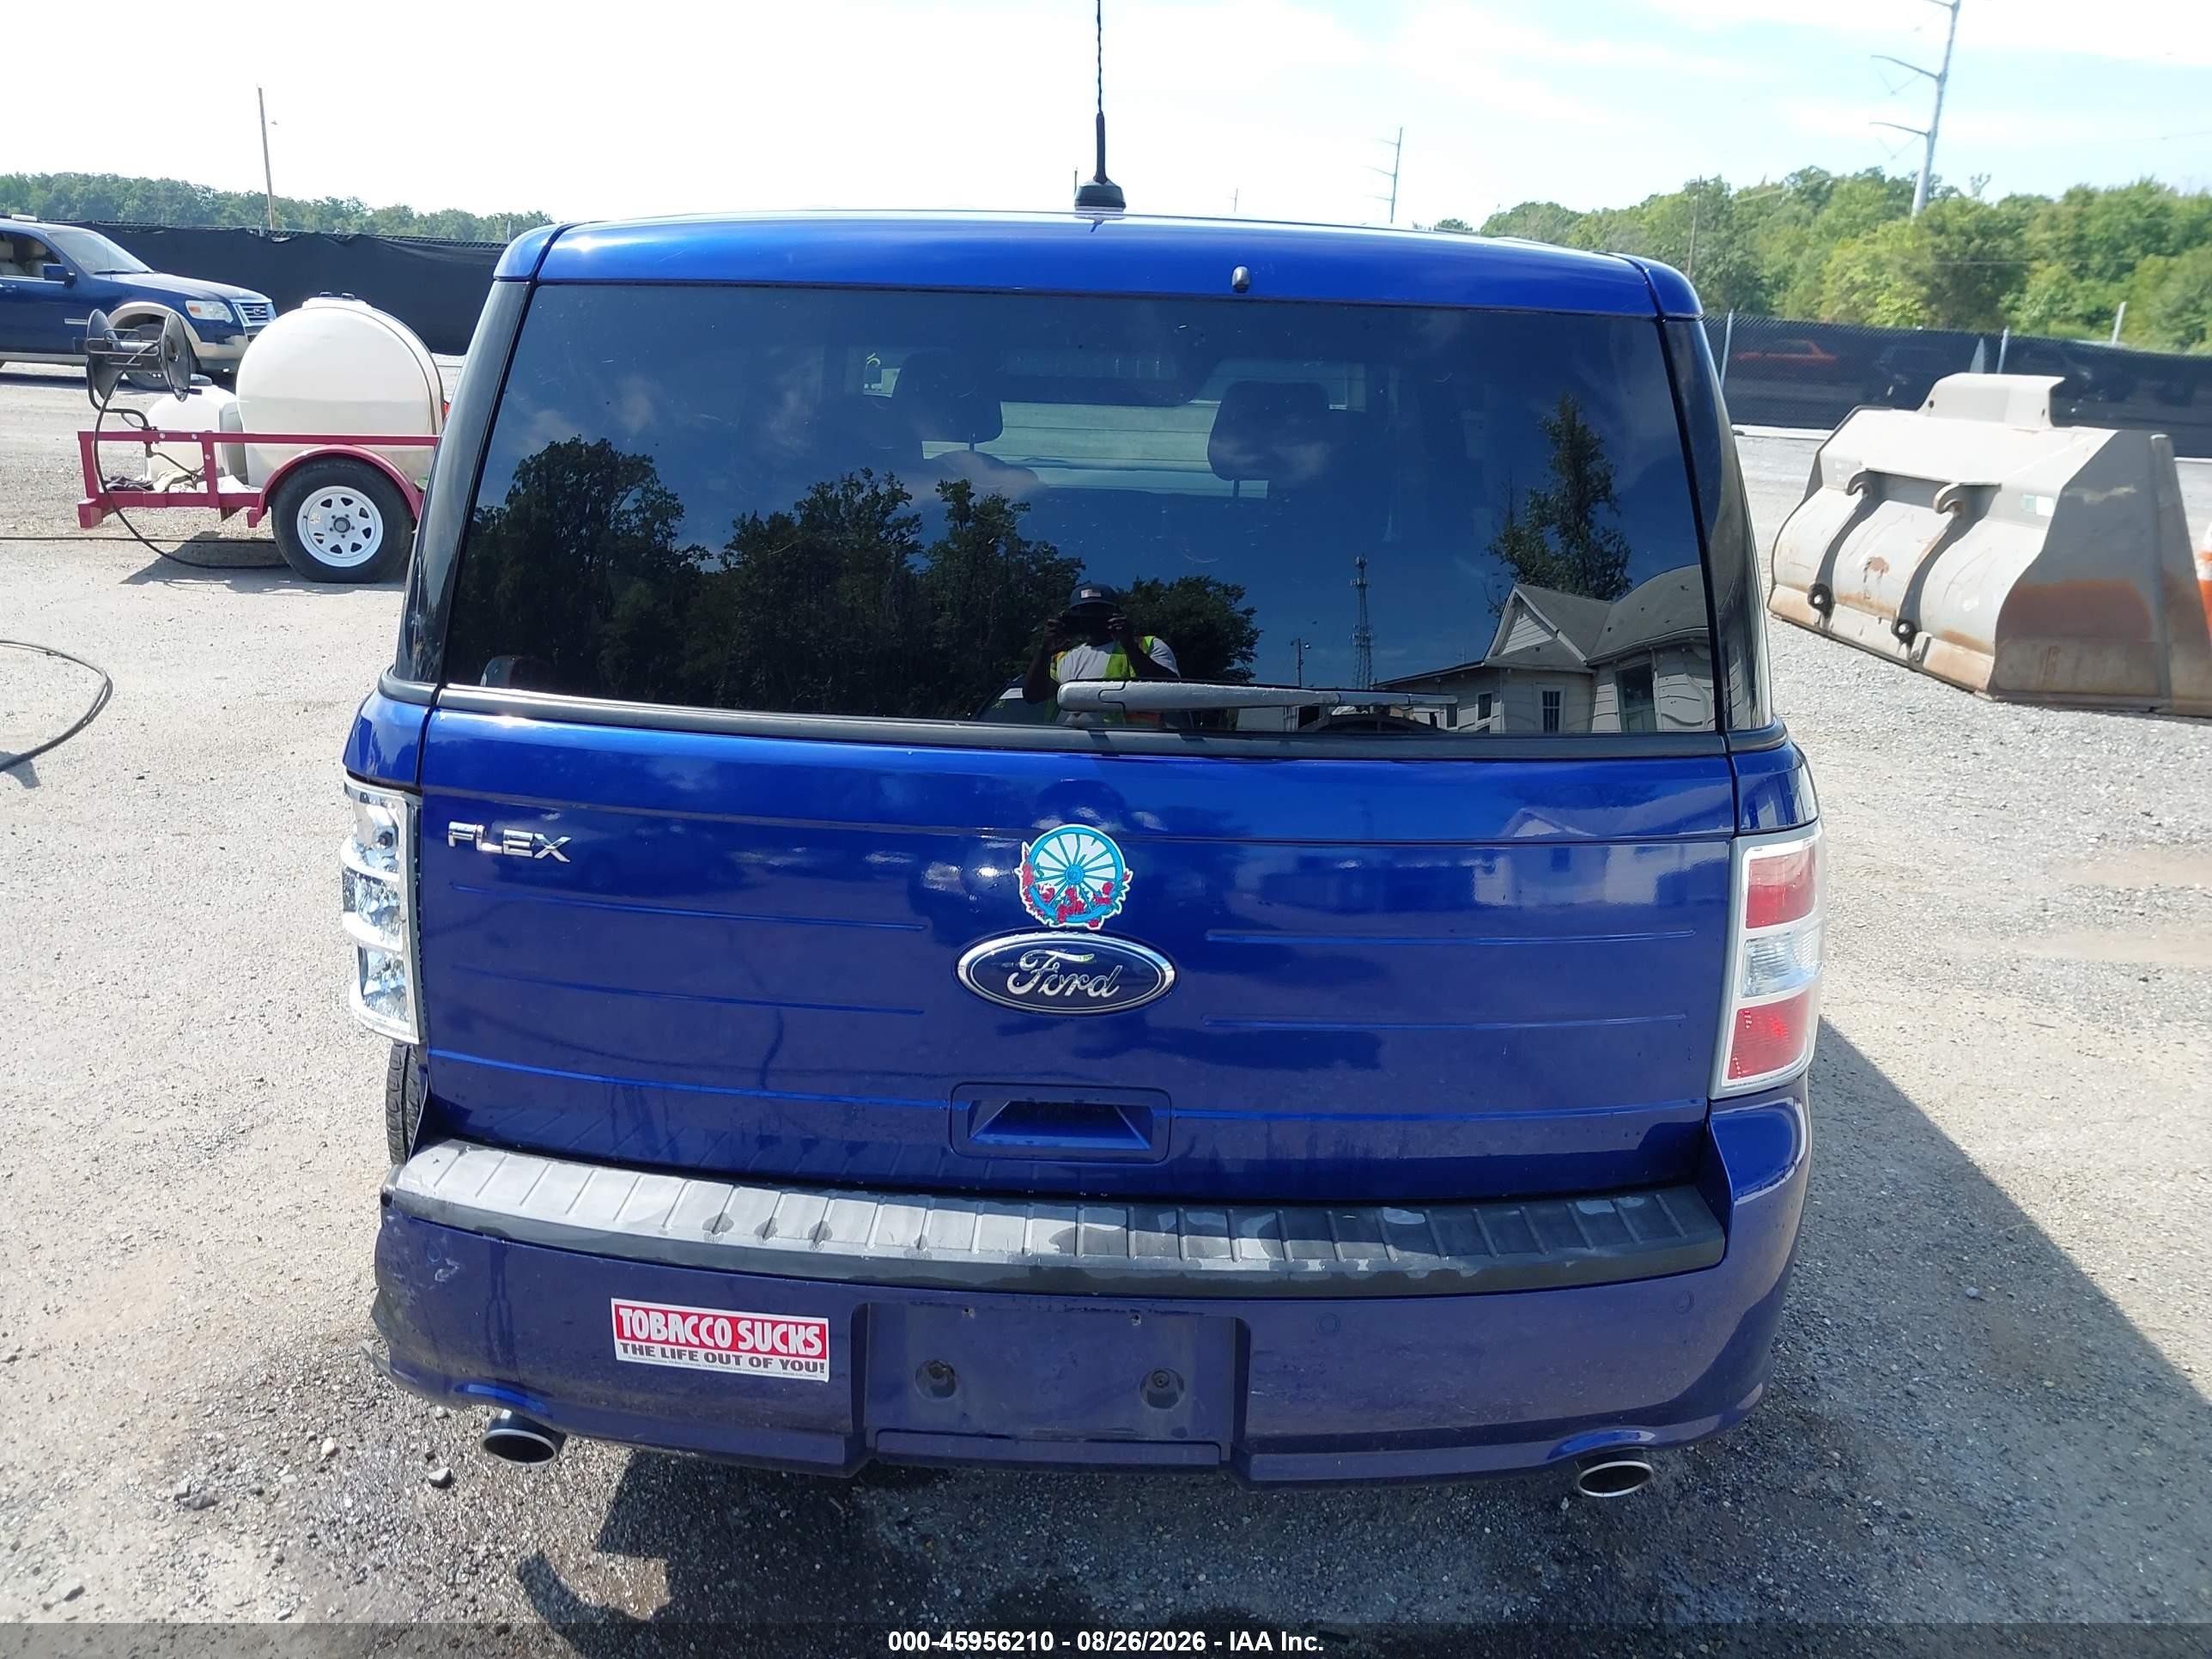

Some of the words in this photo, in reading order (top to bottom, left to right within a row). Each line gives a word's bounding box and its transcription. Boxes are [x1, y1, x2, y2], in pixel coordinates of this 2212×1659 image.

[447, 821, 572, 863] FLEX
[1006, 948, 1124, 998] Ford
[618, 1307, 732, 1349] TOBACCO
[738, 1320, 823, 1357] SUCKS
[620, 1342, 656, 1358] THE
[660, 1346, 699, 1362] LIFE
[704, 1352, 743, 1367] OUT
[749, 1356, 775, 1369] OF
[781, 1359, 825, 1374] YOU!
